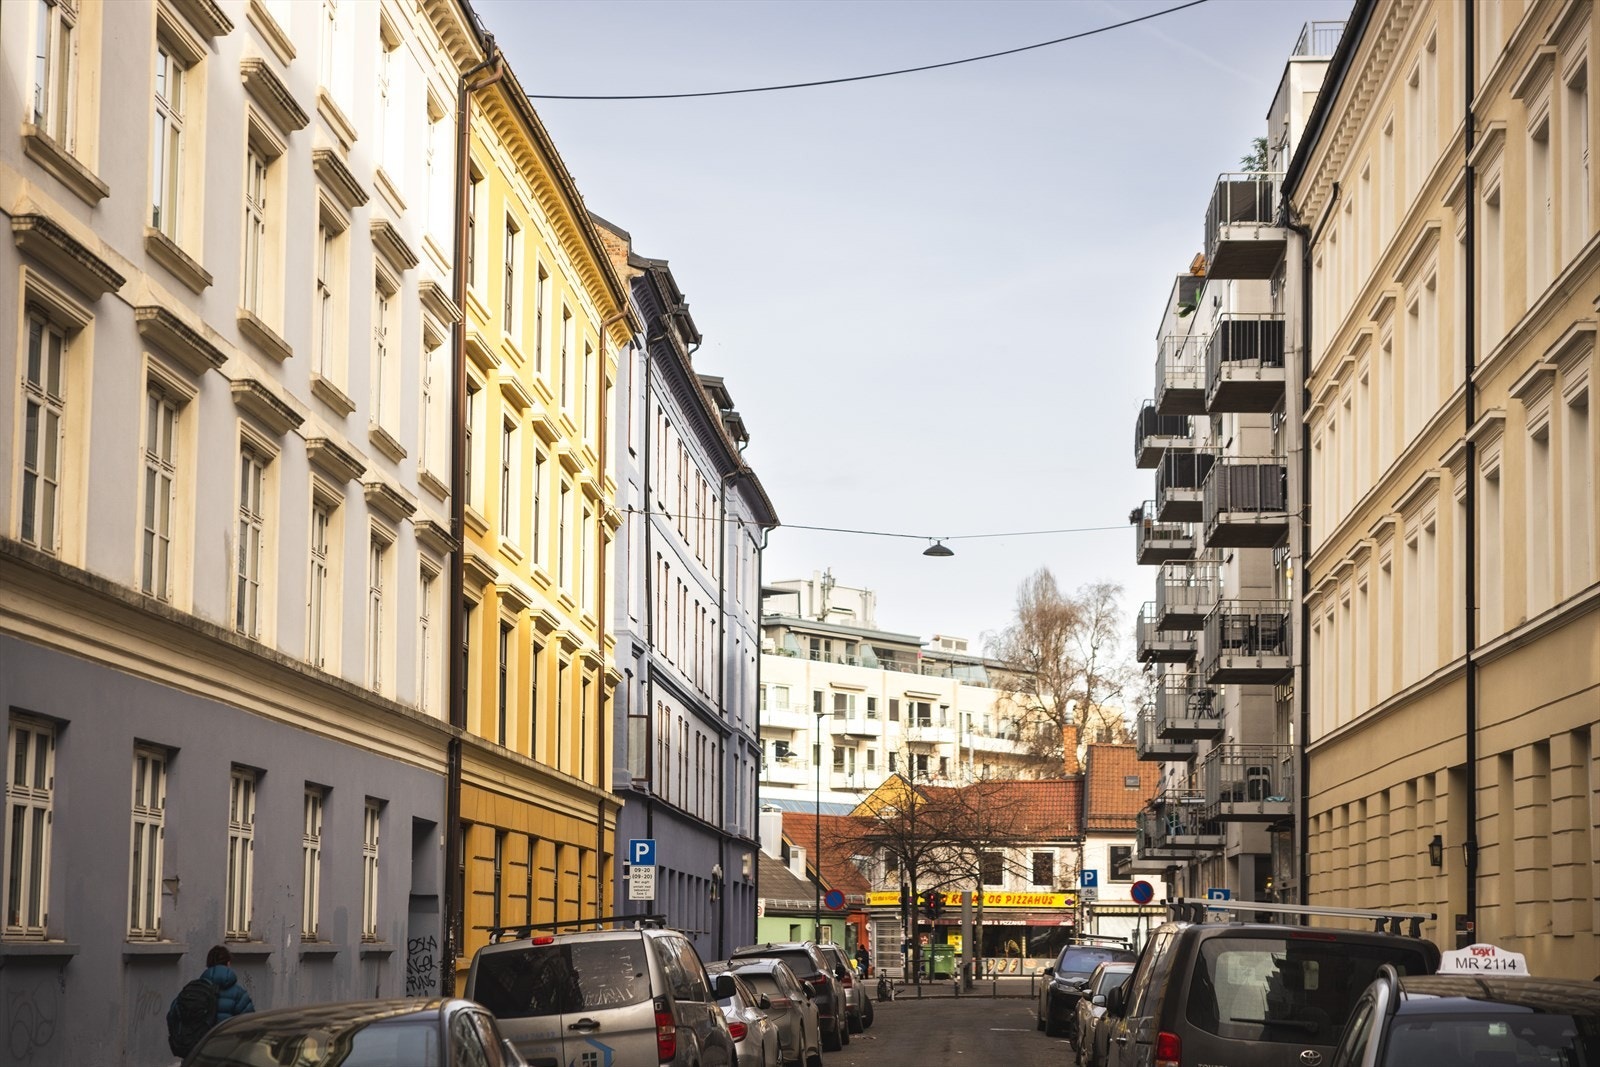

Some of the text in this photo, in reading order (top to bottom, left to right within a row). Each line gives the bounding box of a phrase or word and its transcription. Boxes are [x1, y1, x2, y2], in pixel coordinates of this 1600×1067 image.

[636, 843, 649, 862] P
[1084, 872, 1094, 884] P
[988, 895, 1001, 903] OG
[1005, 895, 1055, 904] PIZZAHUS
[1456, 958, 1516, 970] MR 2114
